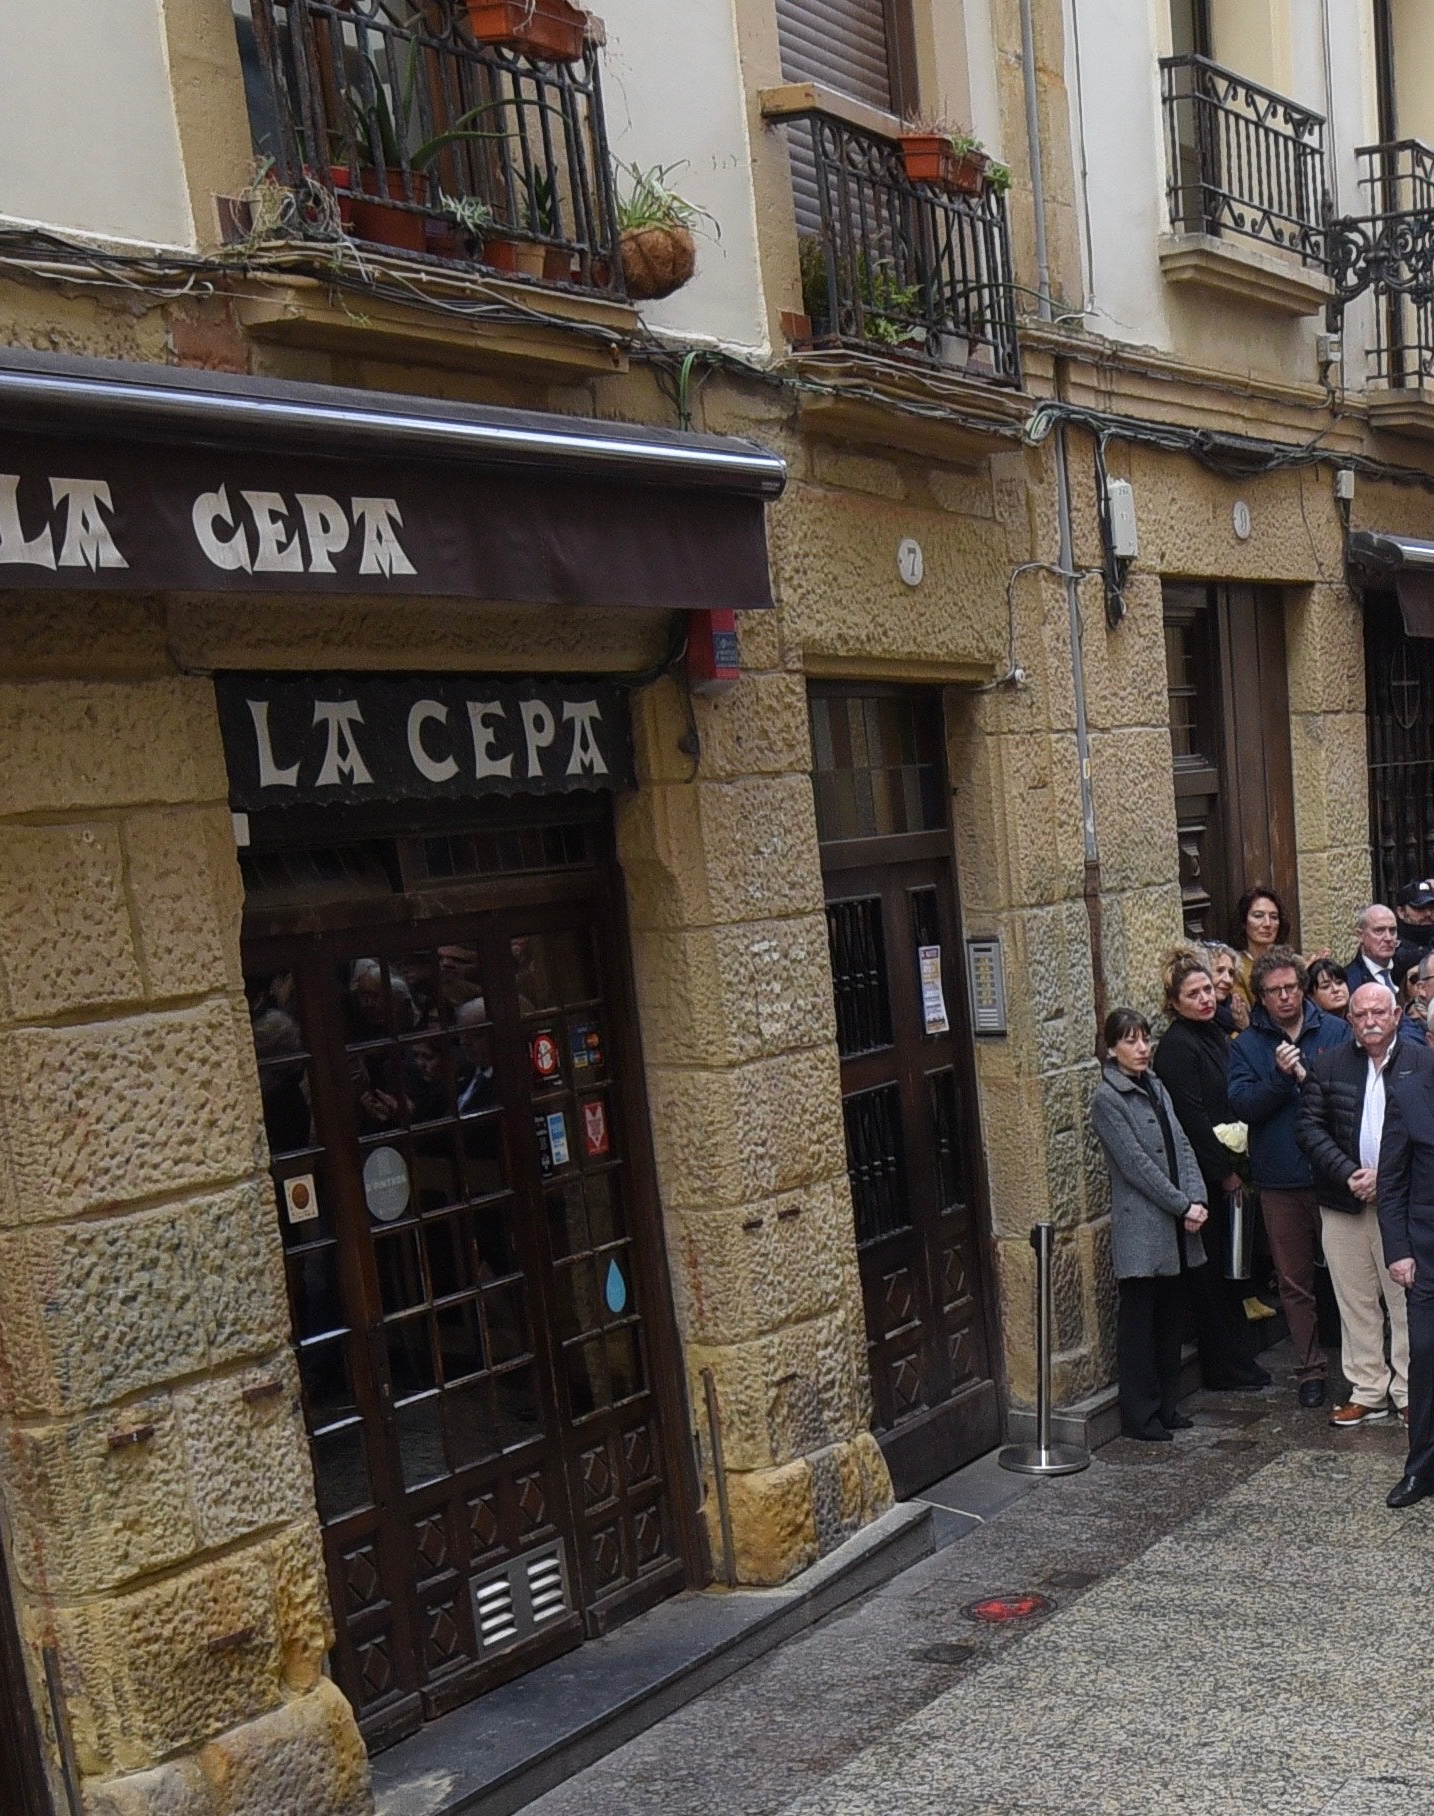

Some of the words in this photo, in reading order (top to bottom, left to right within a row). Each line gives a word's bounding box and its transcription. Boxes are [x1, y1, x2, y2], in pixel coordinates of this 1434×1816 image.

[192, 483, 417, 577] CEPA
[907, 546, 917, 577] 7
[246, 698, 373, 788] LA
[407, 695, 609, 786] CEPA
